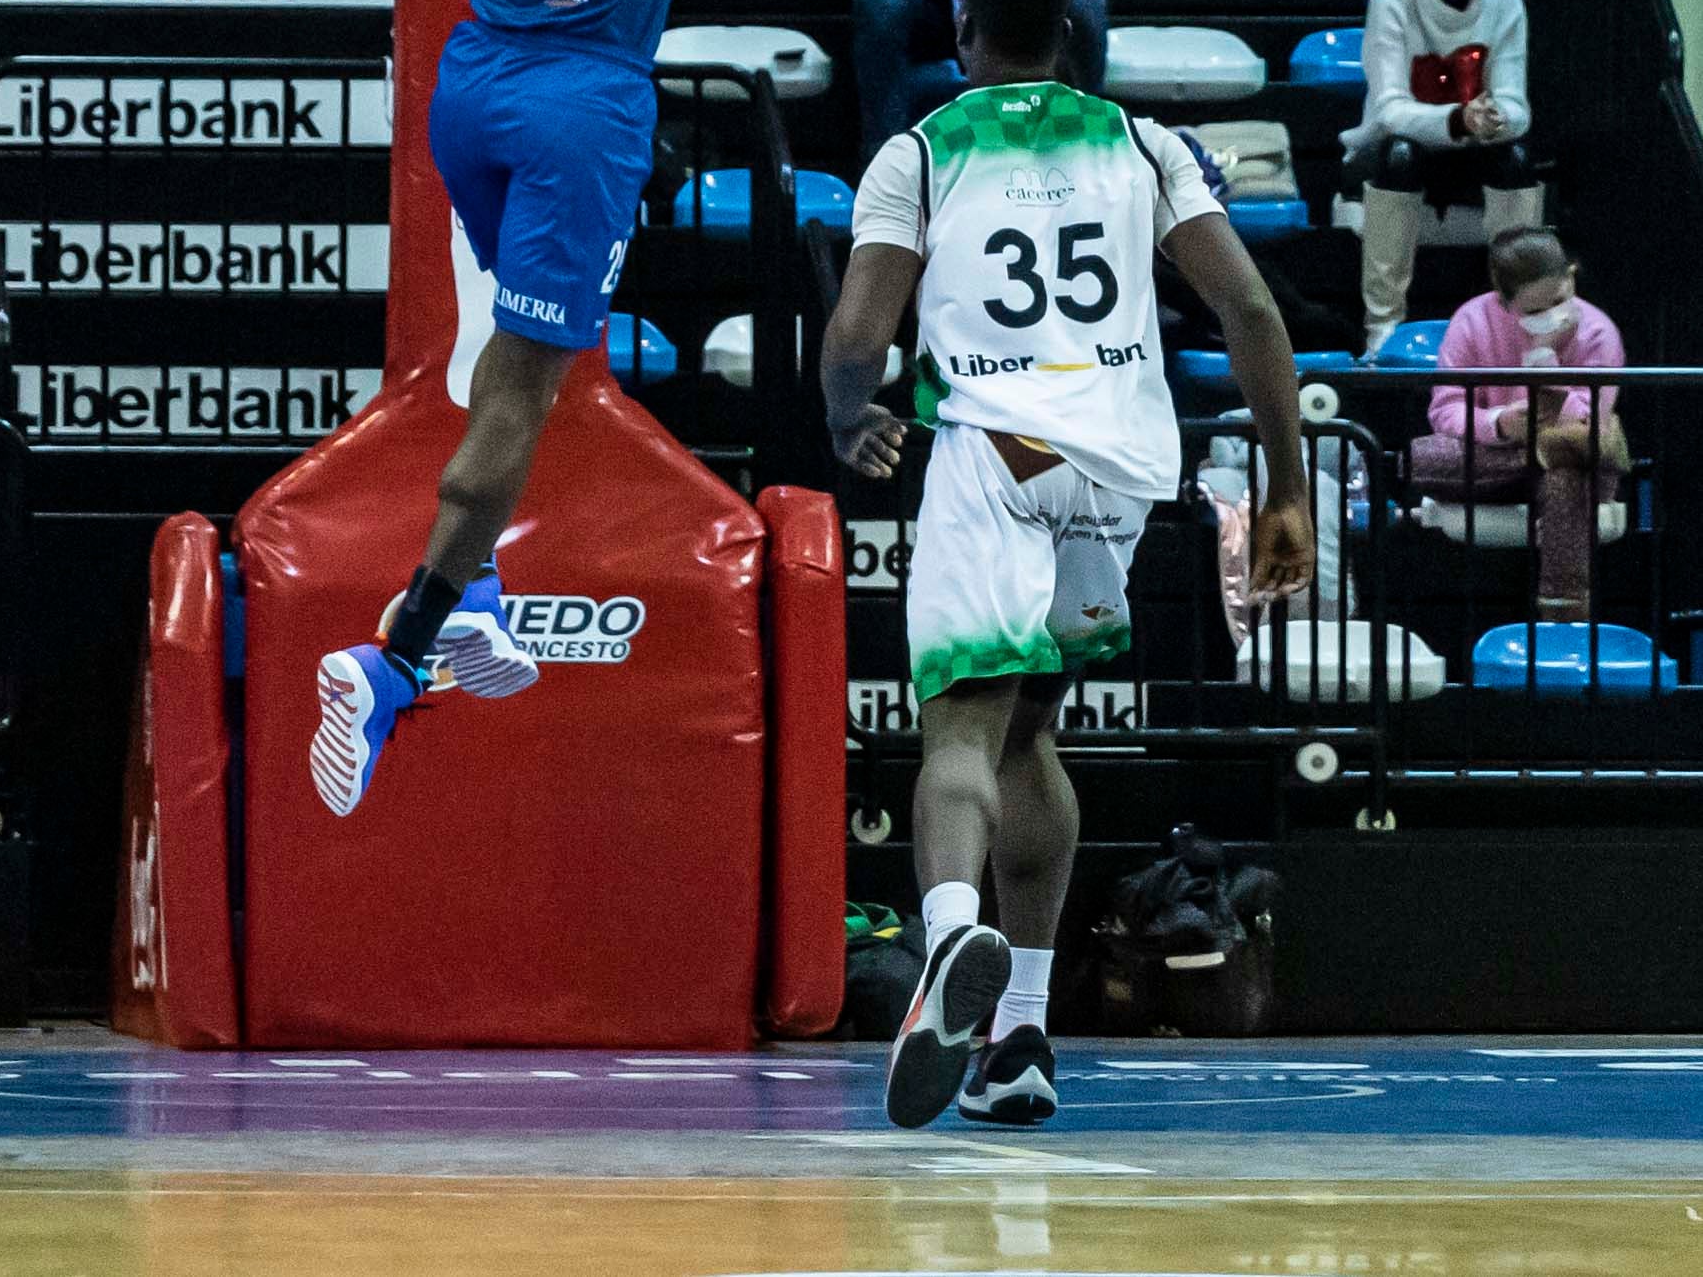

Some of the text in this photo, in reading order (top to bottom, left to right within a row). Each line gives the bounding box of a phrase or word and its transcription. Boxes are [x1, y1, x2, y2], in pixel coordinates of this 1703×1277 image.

[600, 239, 628, 293] 2
[983, 222, 1118, 328] 35
[950, 341, 1147, 378] Liber ban
[506, 600, 640, 635] IEDO
